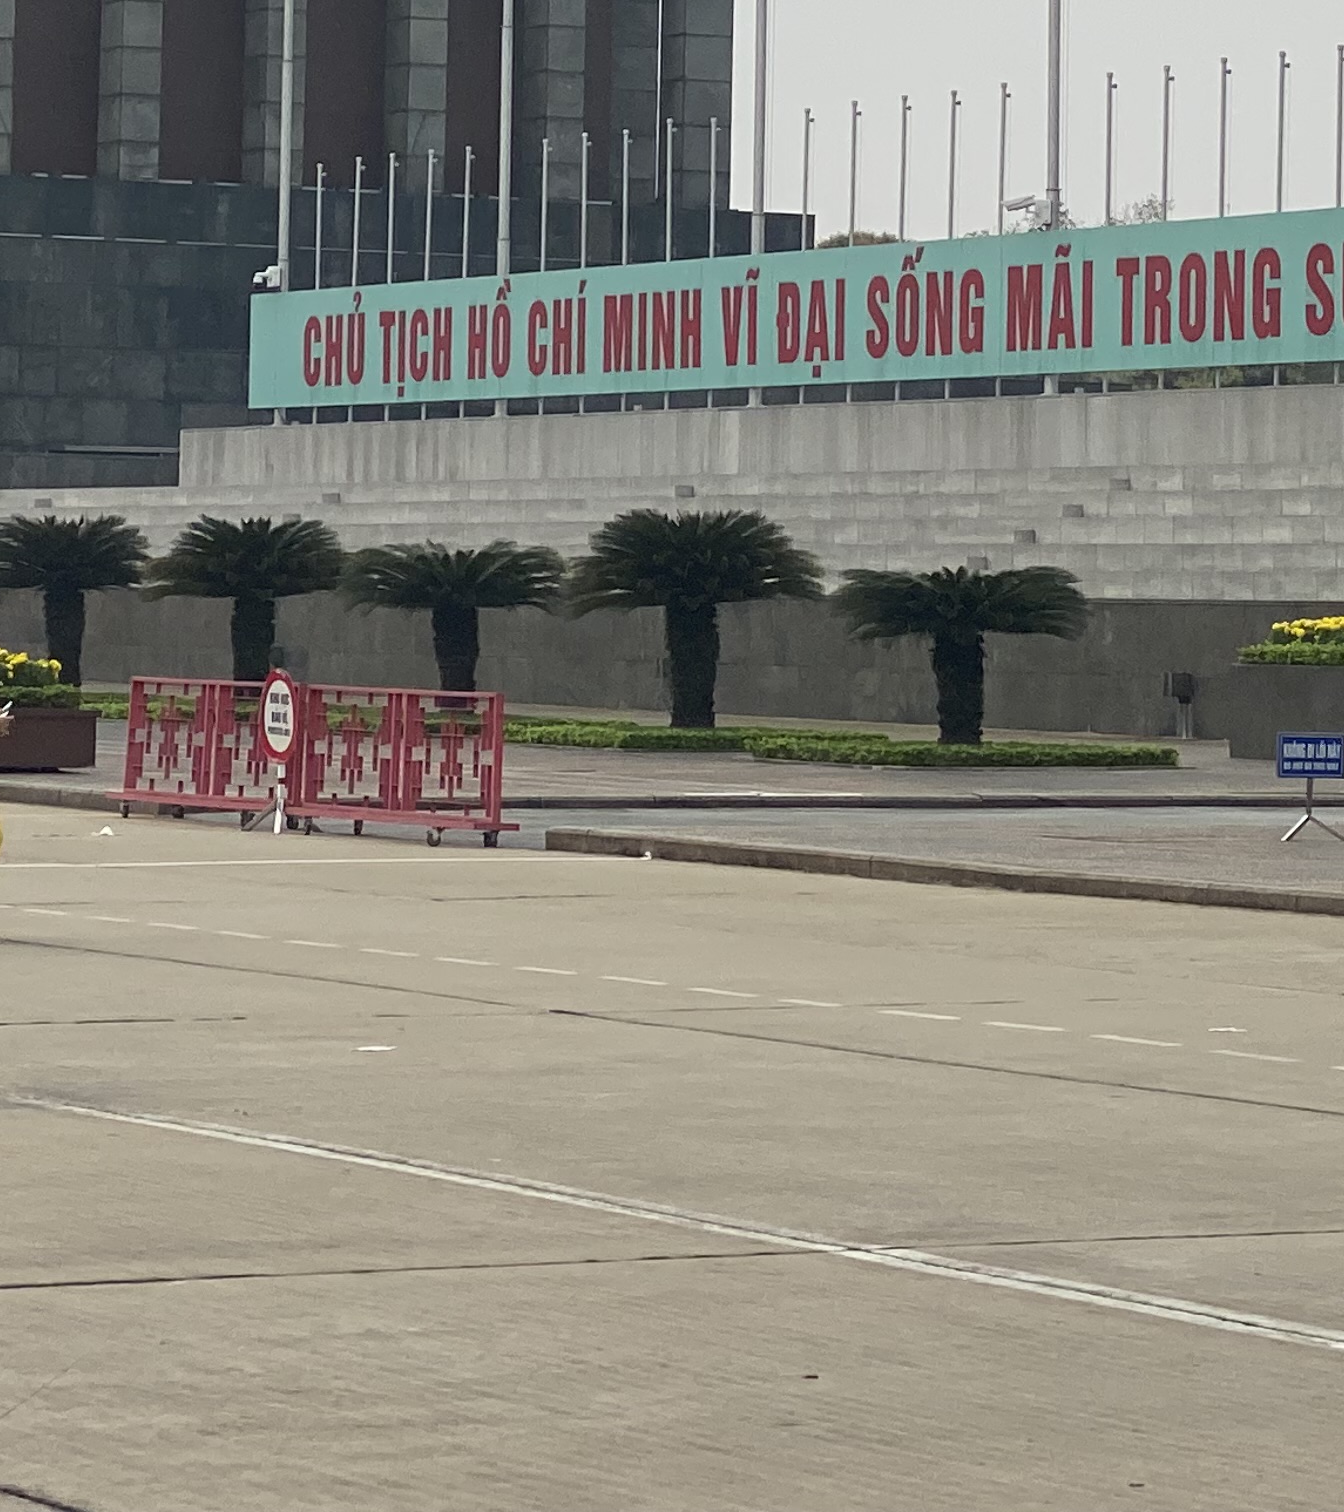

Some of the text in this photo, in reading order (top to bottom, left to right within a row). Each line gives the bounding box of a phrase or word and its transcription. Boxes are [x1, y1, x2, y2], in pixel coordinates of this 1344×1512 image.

[304, 291, 365, 387] CHỦ
[379, 310, 452, 397] TỊCH
[468, 279, 511, 380] HỒ
[528, 280, 587, 377] CHÍ
[603, 288, 701, 373] MINH
[721, 267, 760, 366] VĨ
[776, 277, 846, 378] ĐẠI
[866, 246, 985, 358] SỐNG
[1006, 243, 1093, 352] MÃI
[1116, 246, 1281, 348] TRONG
